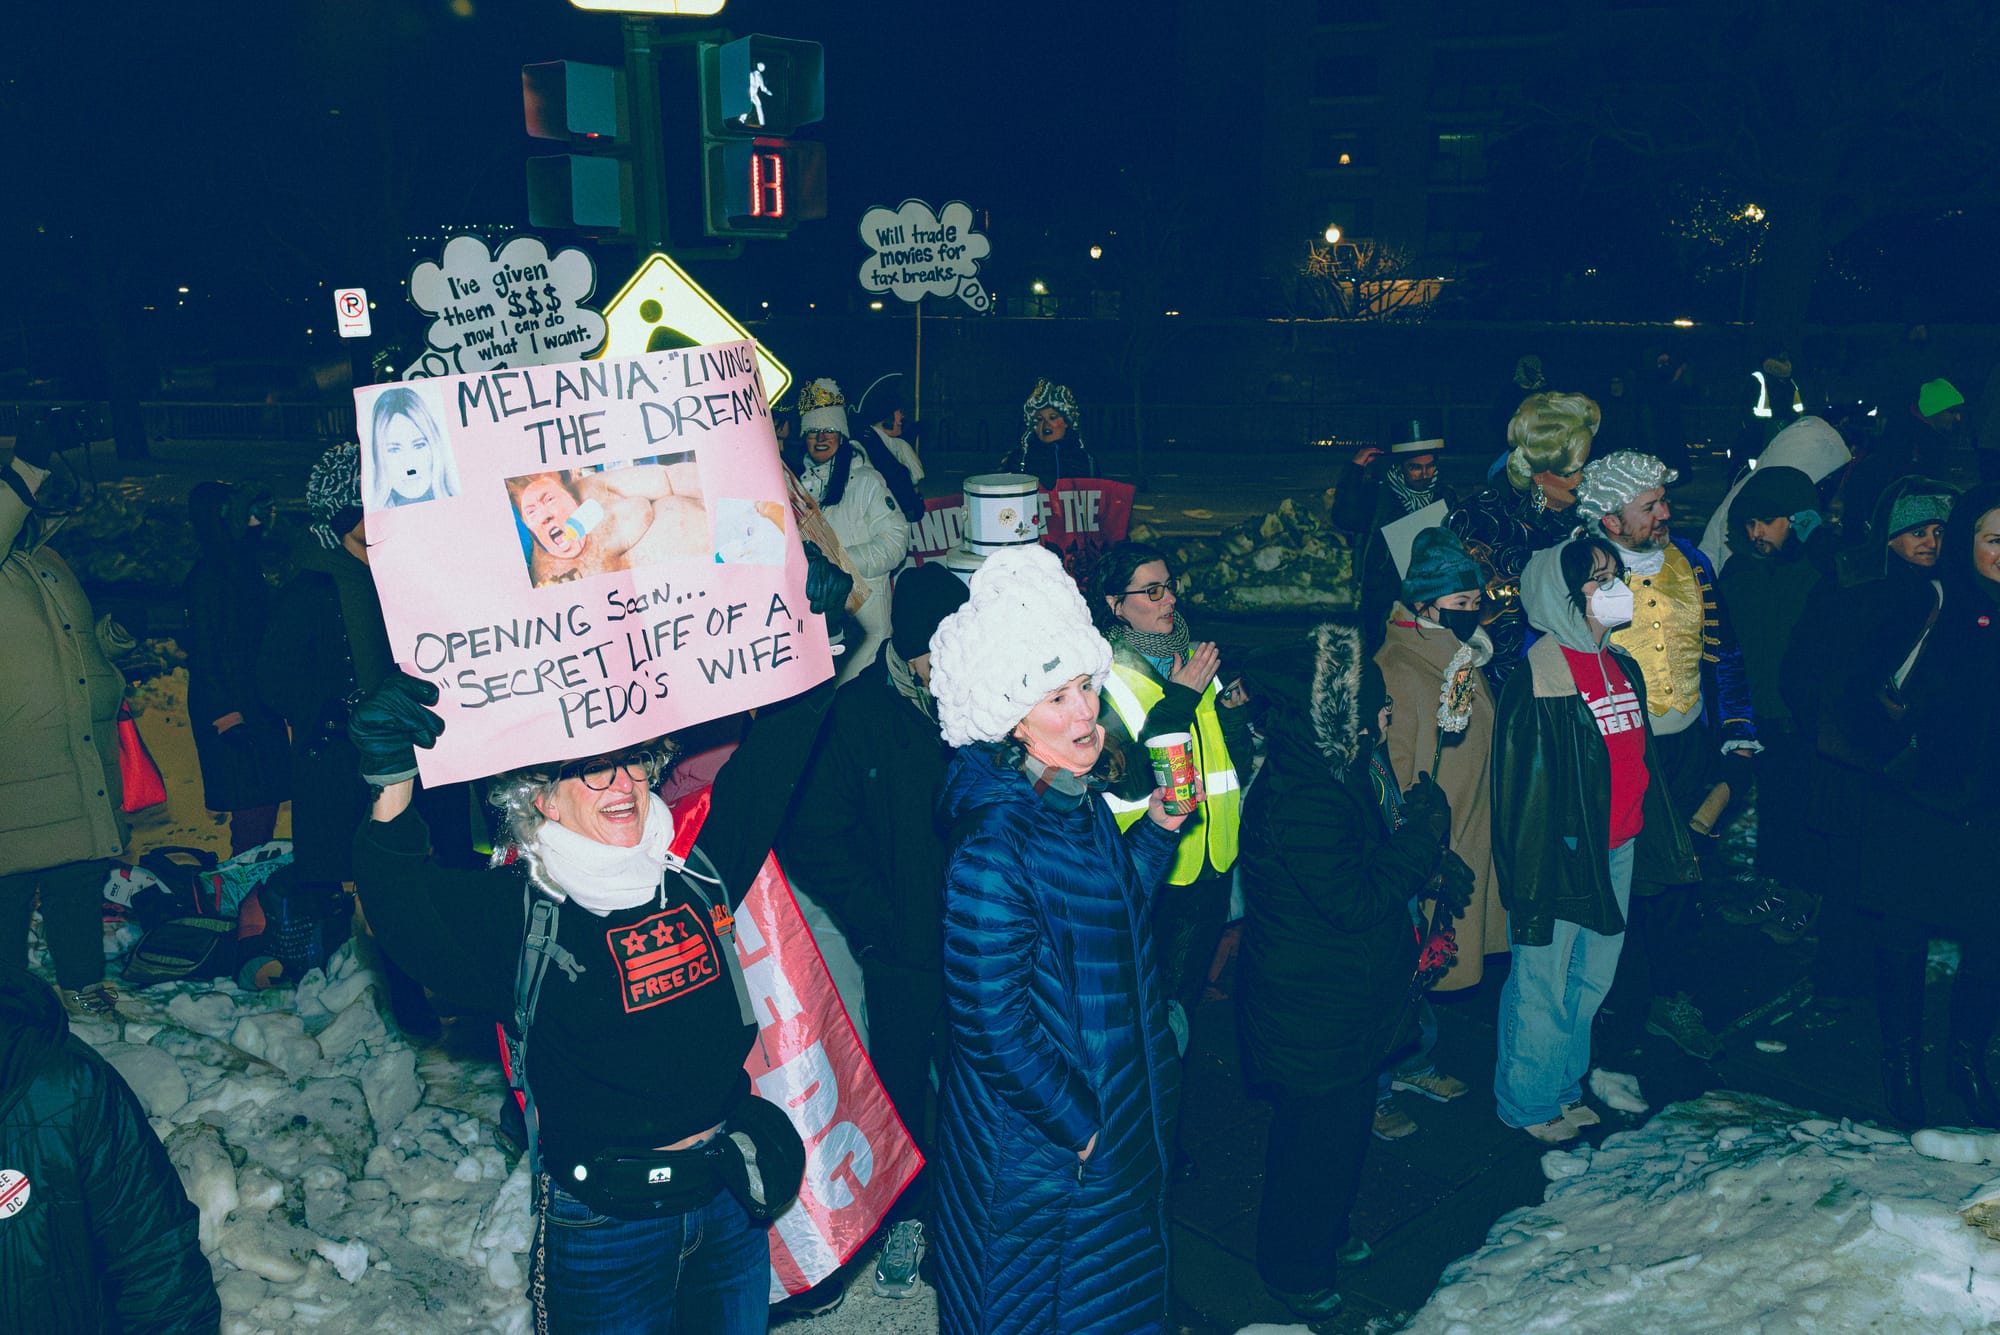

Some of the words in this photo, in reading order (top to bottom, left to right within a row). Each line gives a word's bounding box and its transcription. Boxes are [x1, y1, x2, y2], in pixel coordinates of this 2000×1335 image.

[876, 224, 905, 247] Will
[912, 224, 957, 244] trade
[880, 246, 933, 268] movies
[938, 243, 966, 262] for
[447, 276, 481, 300] I've
[492, 263, 549, 299] given
[871, 269, 900, 286] tax
[902, 266, 957, 284] breaks.
[444, 303, 496, 327] them
[508, 283, 562, 320] $$$
[463, 326, 495, 347] now
[501, 320, 508, 337] I
[514, 318, 540, 335] can
[544, 313, 565, 328] do
[477, 337, 518, 361] what
[529, 332, 539, 354] I
[543, 324, 592, 350] want.
[523, 410, 607, 464] THE
[1058, 490, 1102, 534] THE
[415, 604, 592, 674] OPENING
[626, 614, 695, 672] LIFE
[706, 602, 747, 637] OF
[765, 593, 792, 627] A
[558, 669, 670, 738] PEDO'S
[630, 968, 686, 1003] FREE
[688, 955, 713, 982] DC
[755, 1039, 874, 1210] DC
[6, 1197, 23, 1213] DC
